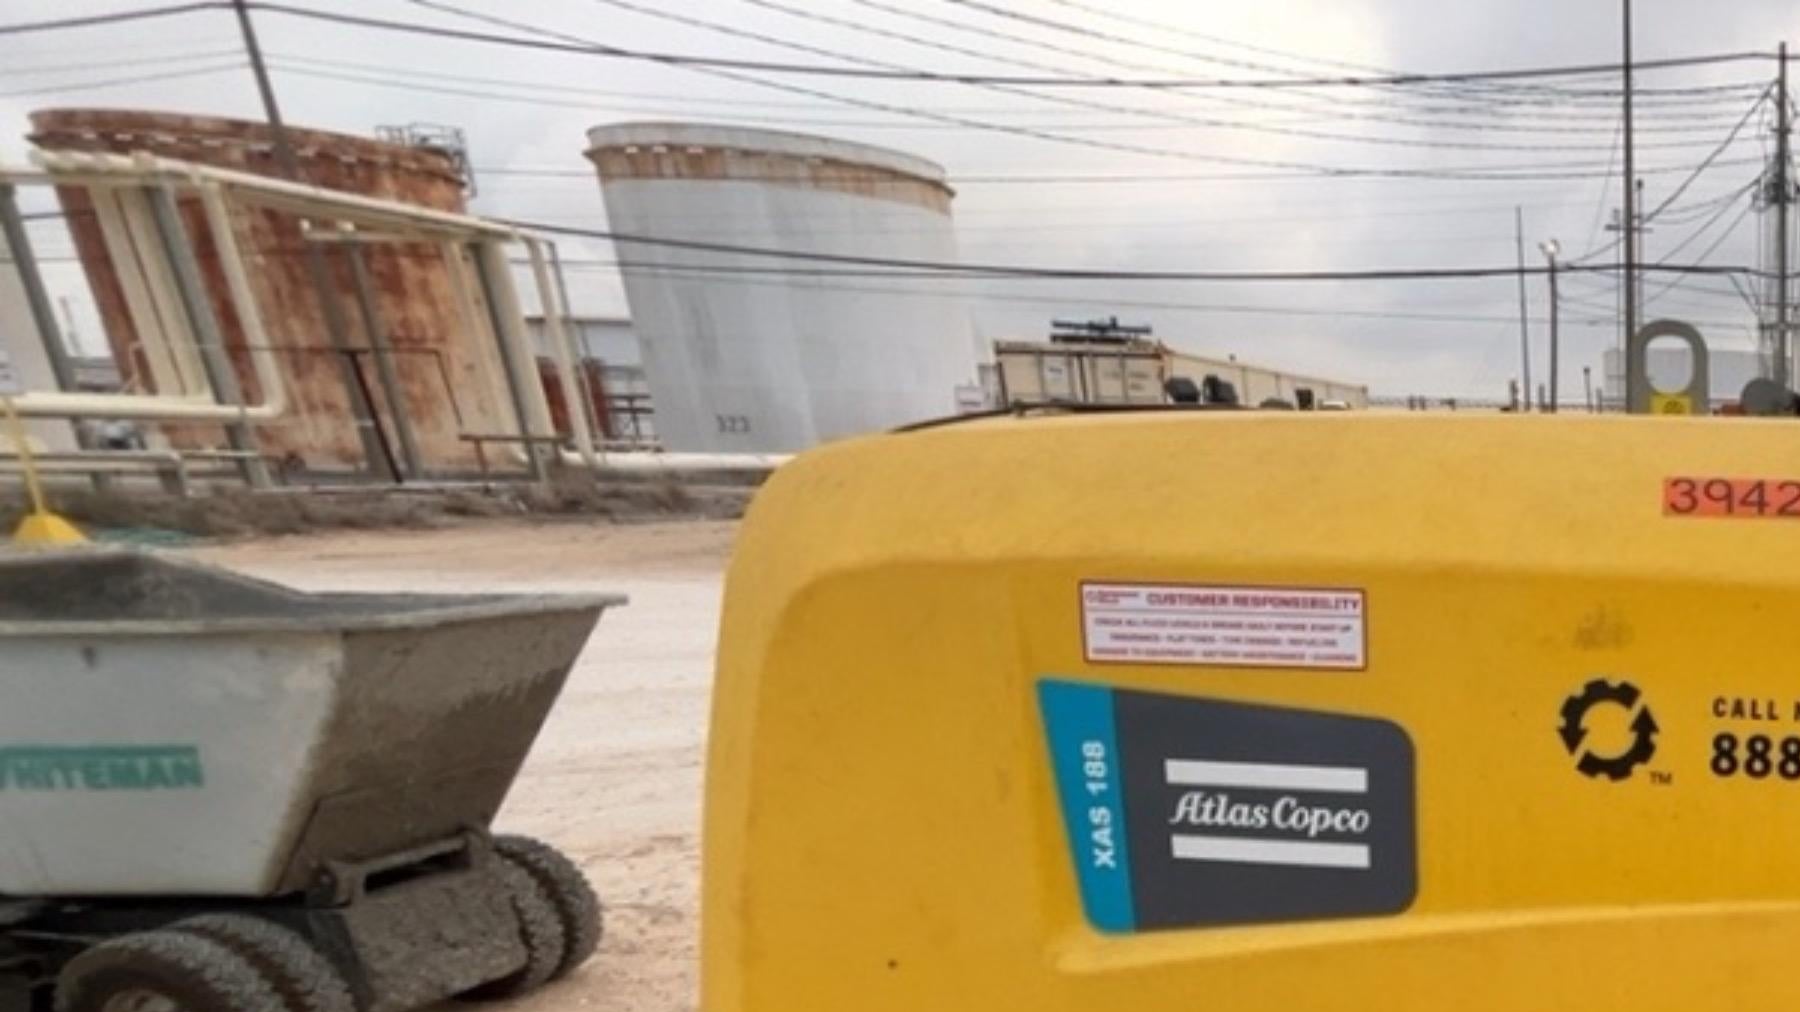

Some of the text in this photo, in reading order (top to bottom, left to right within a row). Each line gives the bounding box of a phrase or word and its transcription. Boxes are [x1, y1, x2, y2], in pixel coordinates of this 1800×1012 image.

[1145, 591, 1230, 608] CUSTOMER
[1232, 595, 1360, 611] RESPONSIBILITY
[1712, 696, 1780, 722] CALL
[1081, 739, 1117, 870] XAS 188
